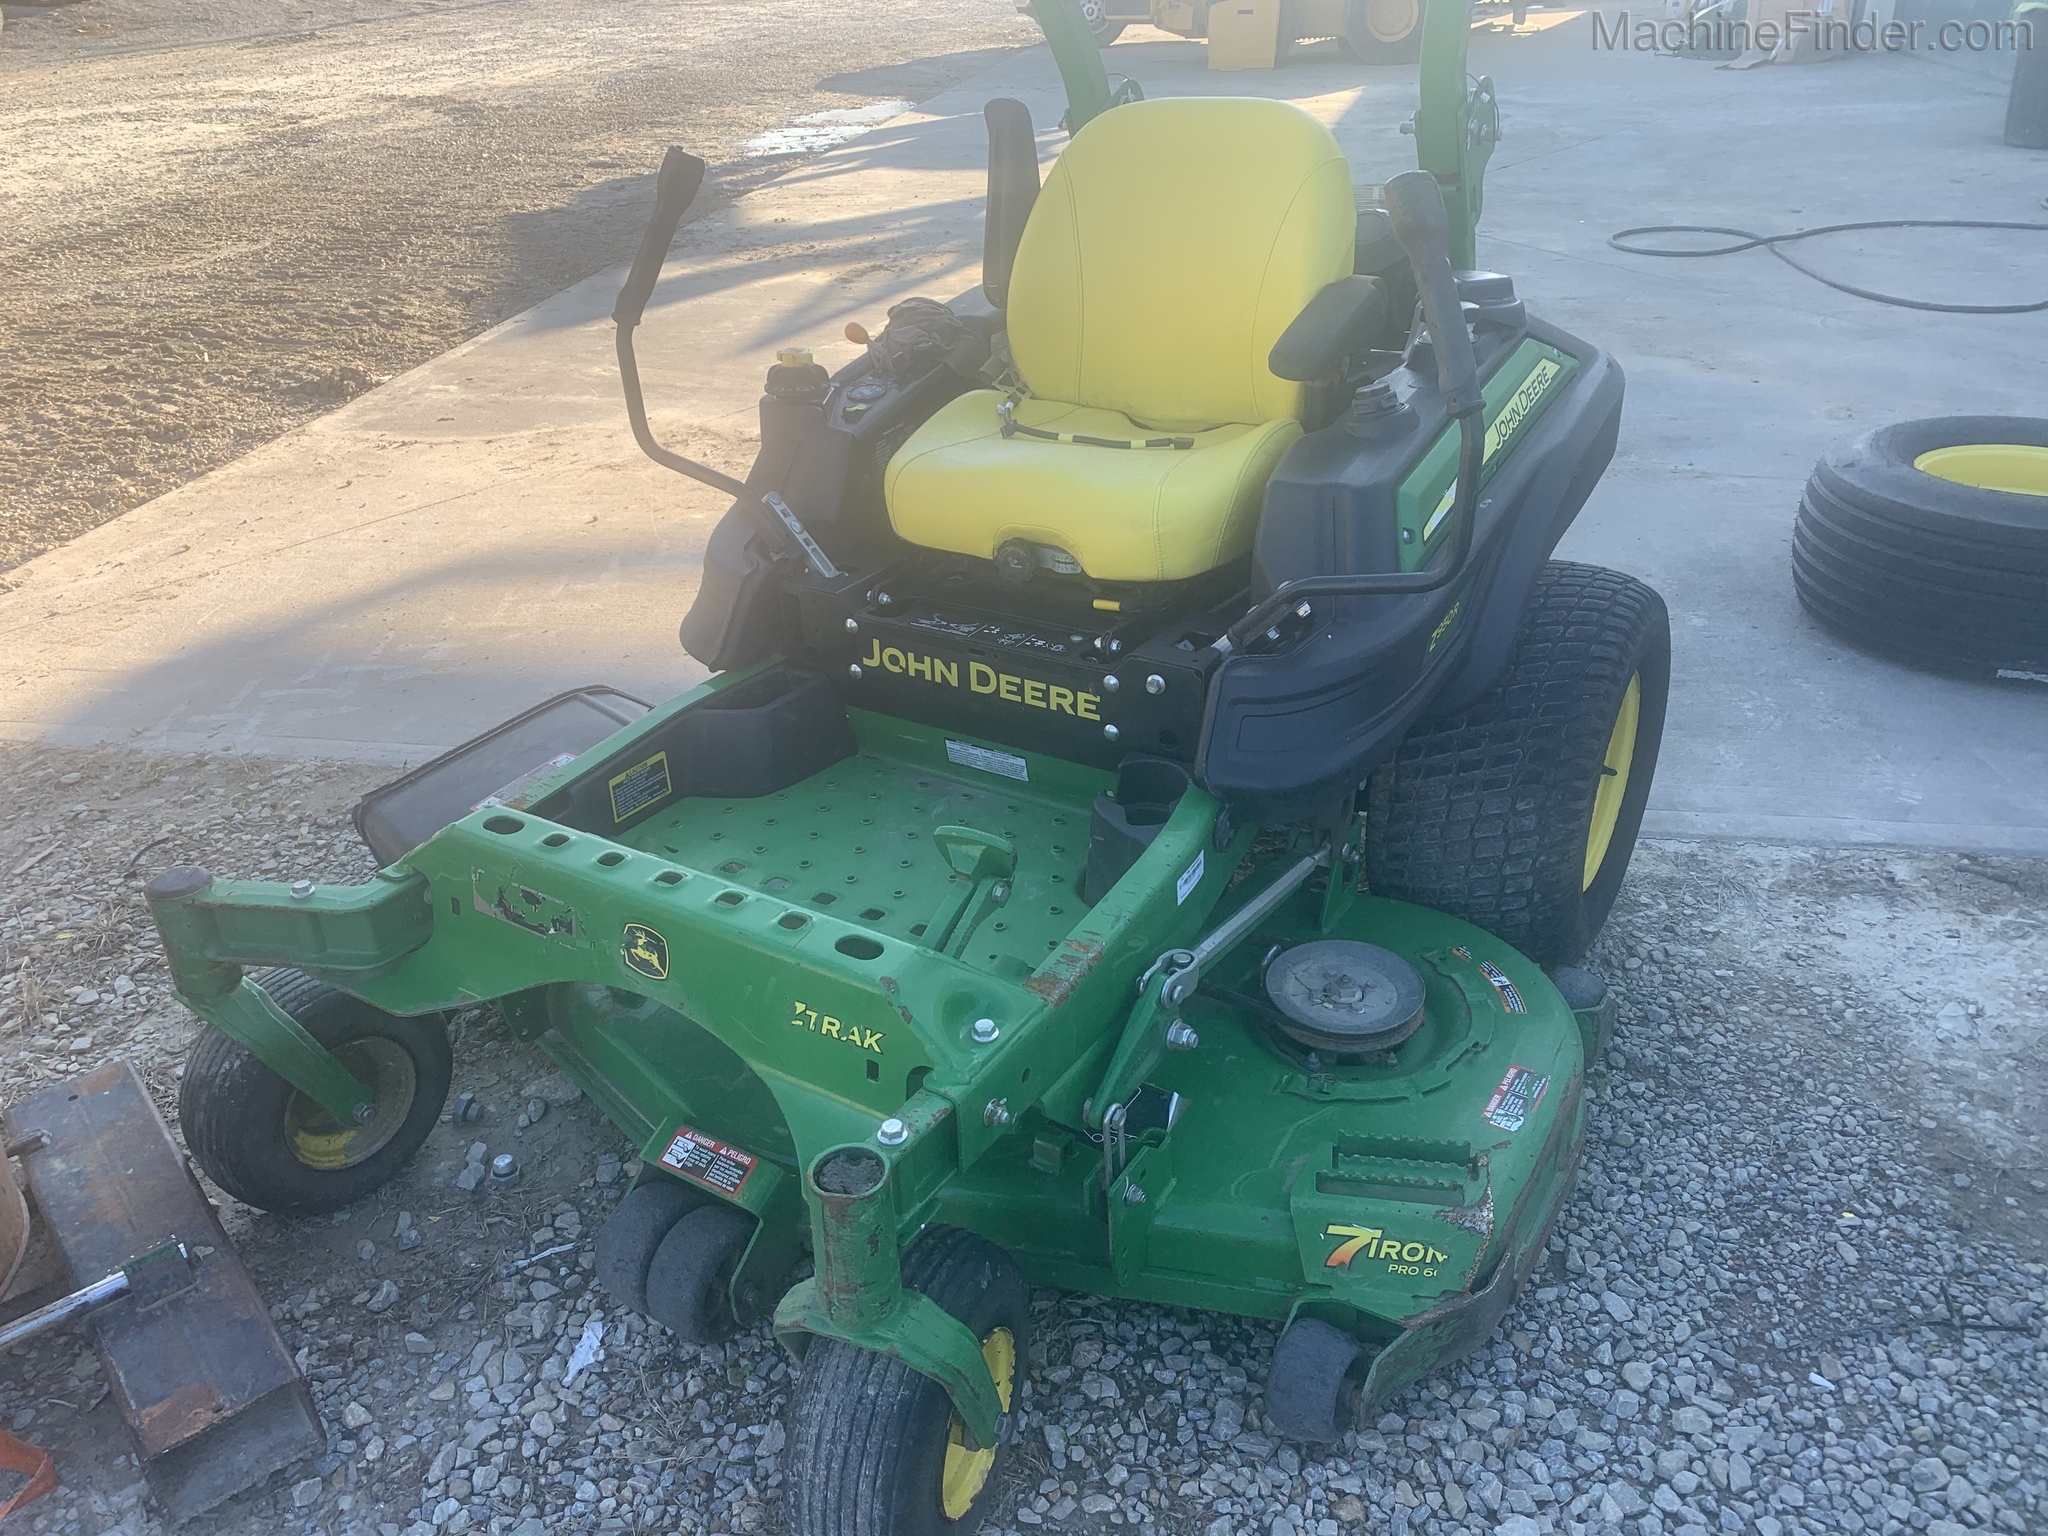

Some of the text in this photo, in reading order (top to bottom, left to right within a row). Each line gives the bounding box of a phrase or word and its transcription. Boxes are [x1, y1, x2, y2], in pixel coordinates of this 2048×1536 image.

[1493, 366, 1550, 447] JOHN DEERE
[862, 638, 1101, 721] JOHN DEERE
[692, 1133, 716, 1149] DANGER
[727, 1149, 752, 1165] PELIGRO
[1387, 1264, 1420, 1276] PRO
